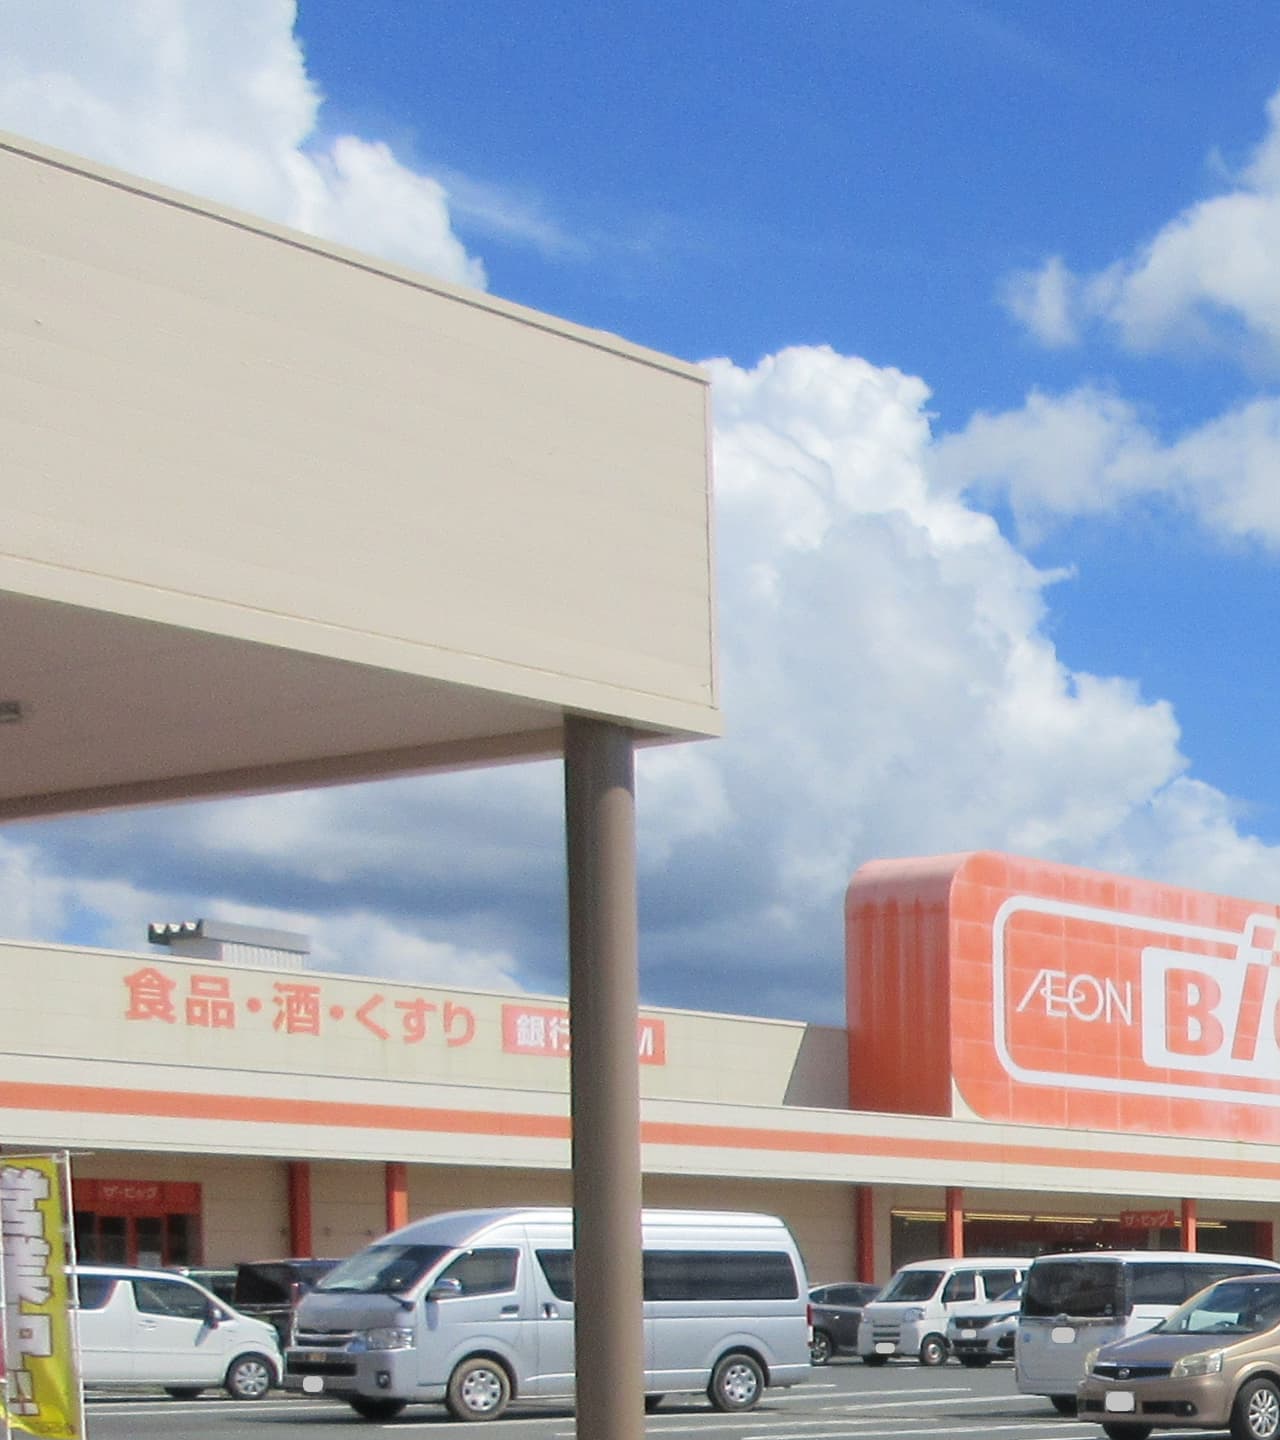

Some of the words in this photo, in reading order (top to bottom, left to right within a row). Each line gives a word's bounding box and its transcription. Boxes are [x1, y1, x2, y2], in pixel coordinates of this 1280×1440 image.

[124, 966, 476, 1048] 食品・酒・くすり
